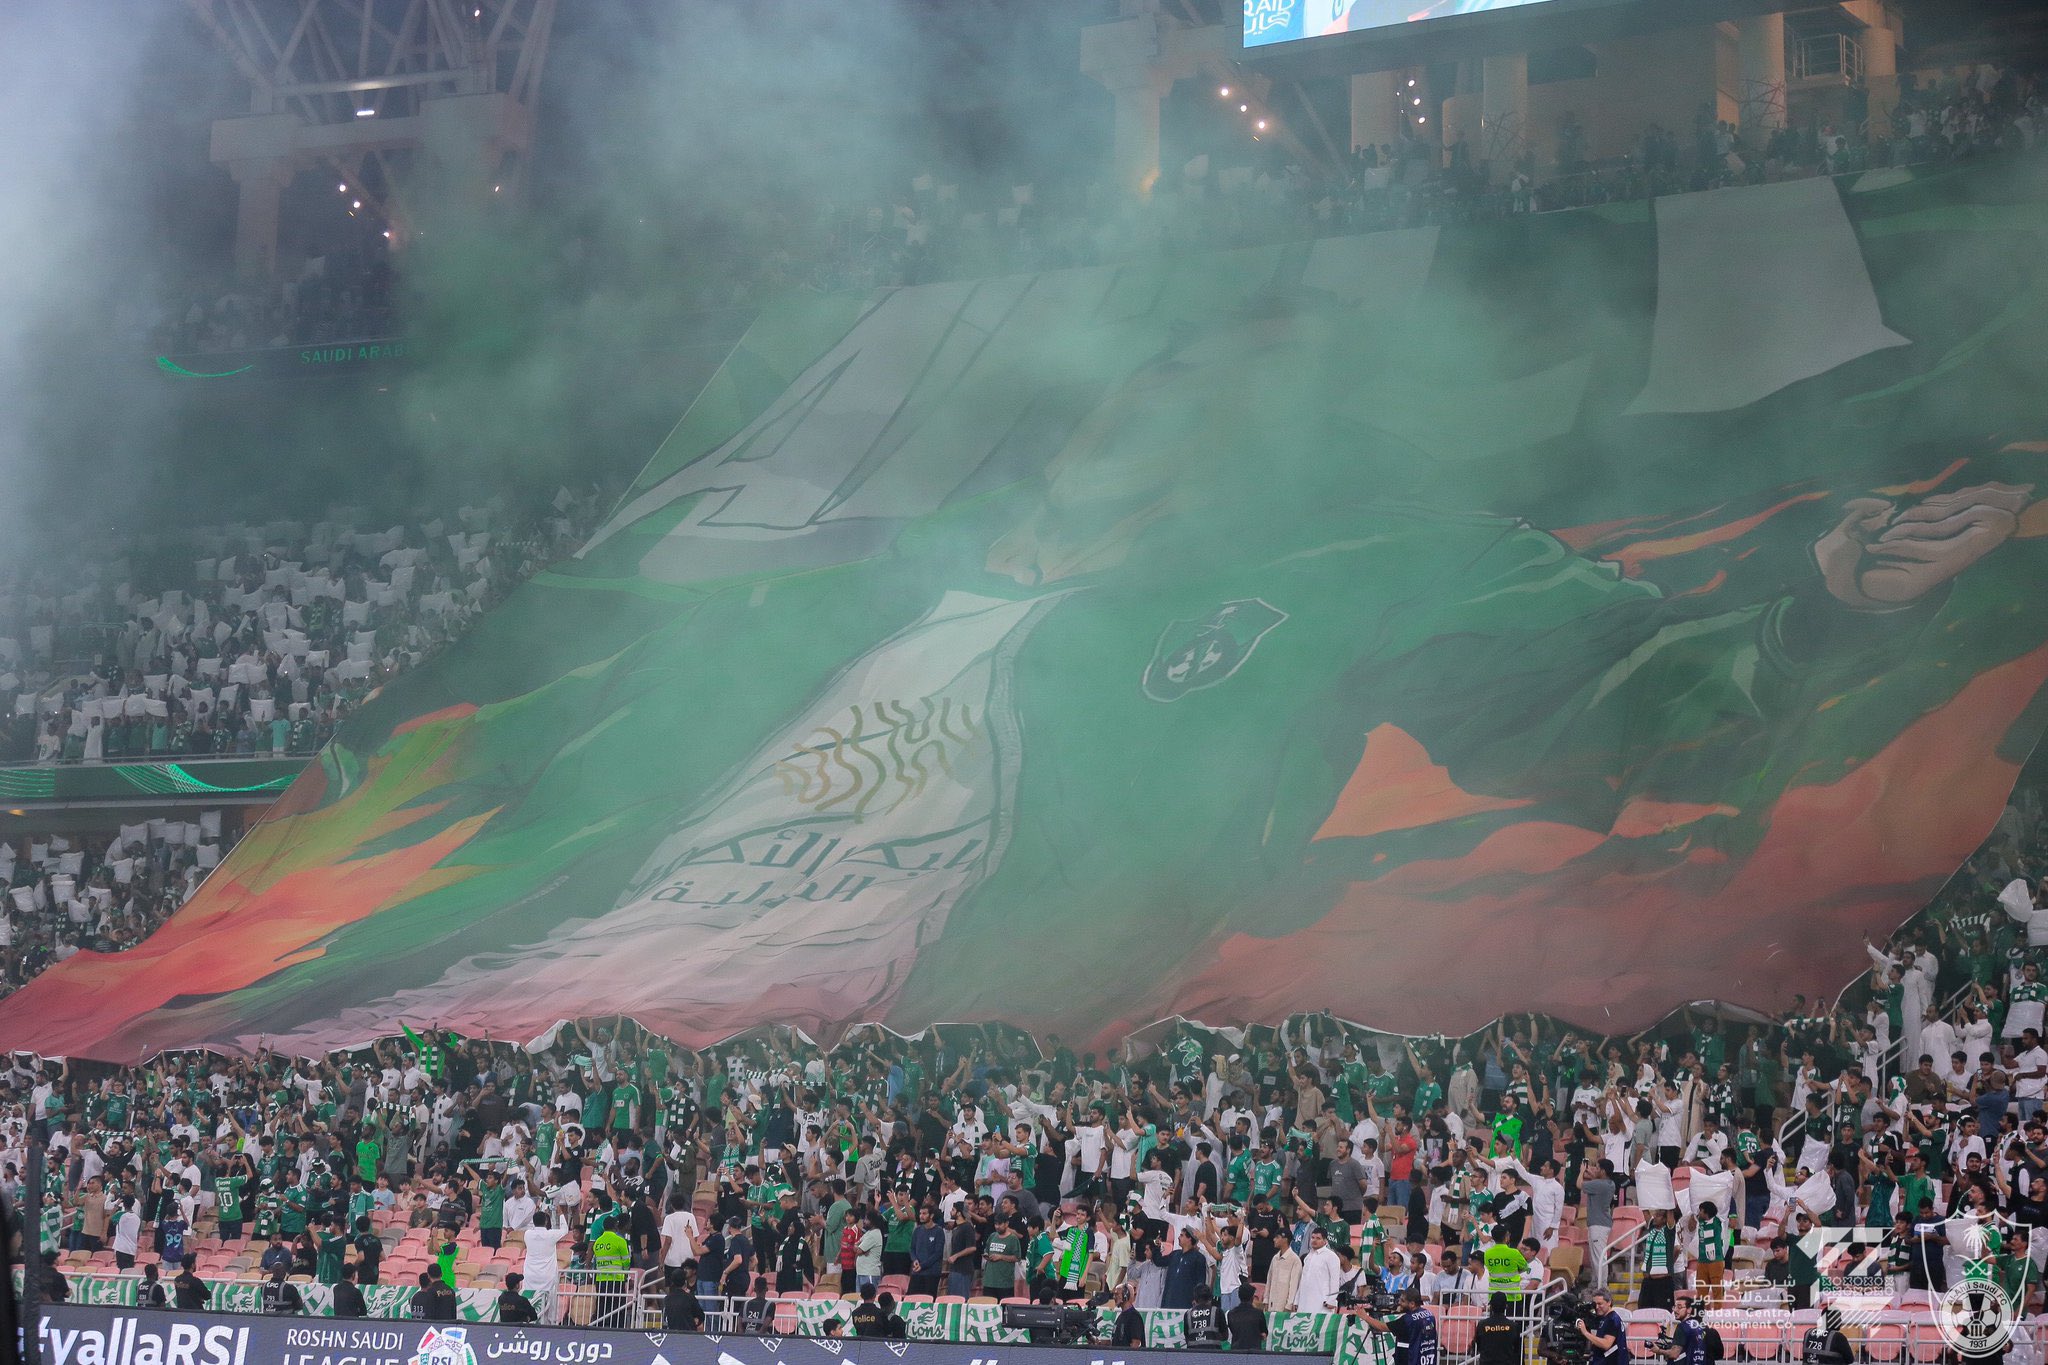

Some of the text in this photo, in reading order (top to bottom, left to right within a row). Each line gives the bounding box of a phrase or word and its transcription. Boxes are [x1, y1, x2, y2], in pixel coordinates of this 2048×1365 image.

[300, 348, 352, 364] SAUDI
[218, 1191, 233, 1207] 10
[165, 1233, 182, 1248] 99
[1488, 1258, 1511, 1267] EPIC
[854, 1314, 876, 1324] Police
[1193, 1320, 1208, 1329] 738
[1485, 1325, 1510, 1333] Police
[287, 1328, 403, 1351] ROSHN SAUDI
[1274, 1327, 1318, 1350] Lions
[1808, 1340, 1822, 1350] 728
[487, 1330, 613, 1365] دوري روشن
